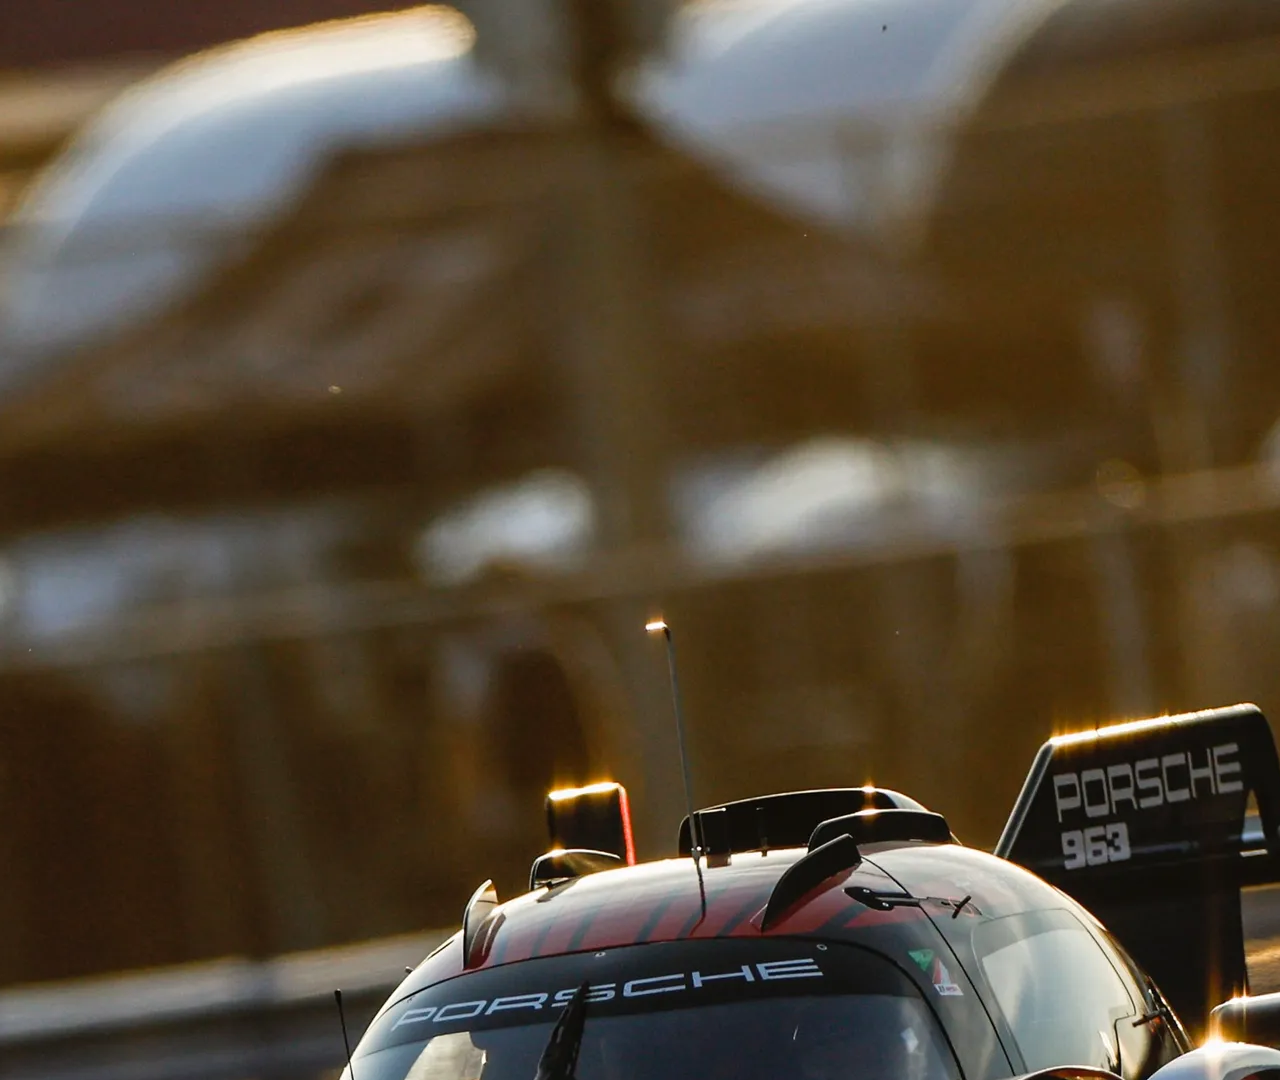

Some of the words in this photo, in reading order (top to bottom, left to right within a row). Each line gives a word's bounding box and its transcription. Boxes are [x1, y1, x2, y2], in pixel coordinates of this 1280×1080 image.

[1053, 743, 1244, 823] PORSCHE
[1061, 822, 1131, 870] 963
[391, 958, 824, 1032] PORSCHE
